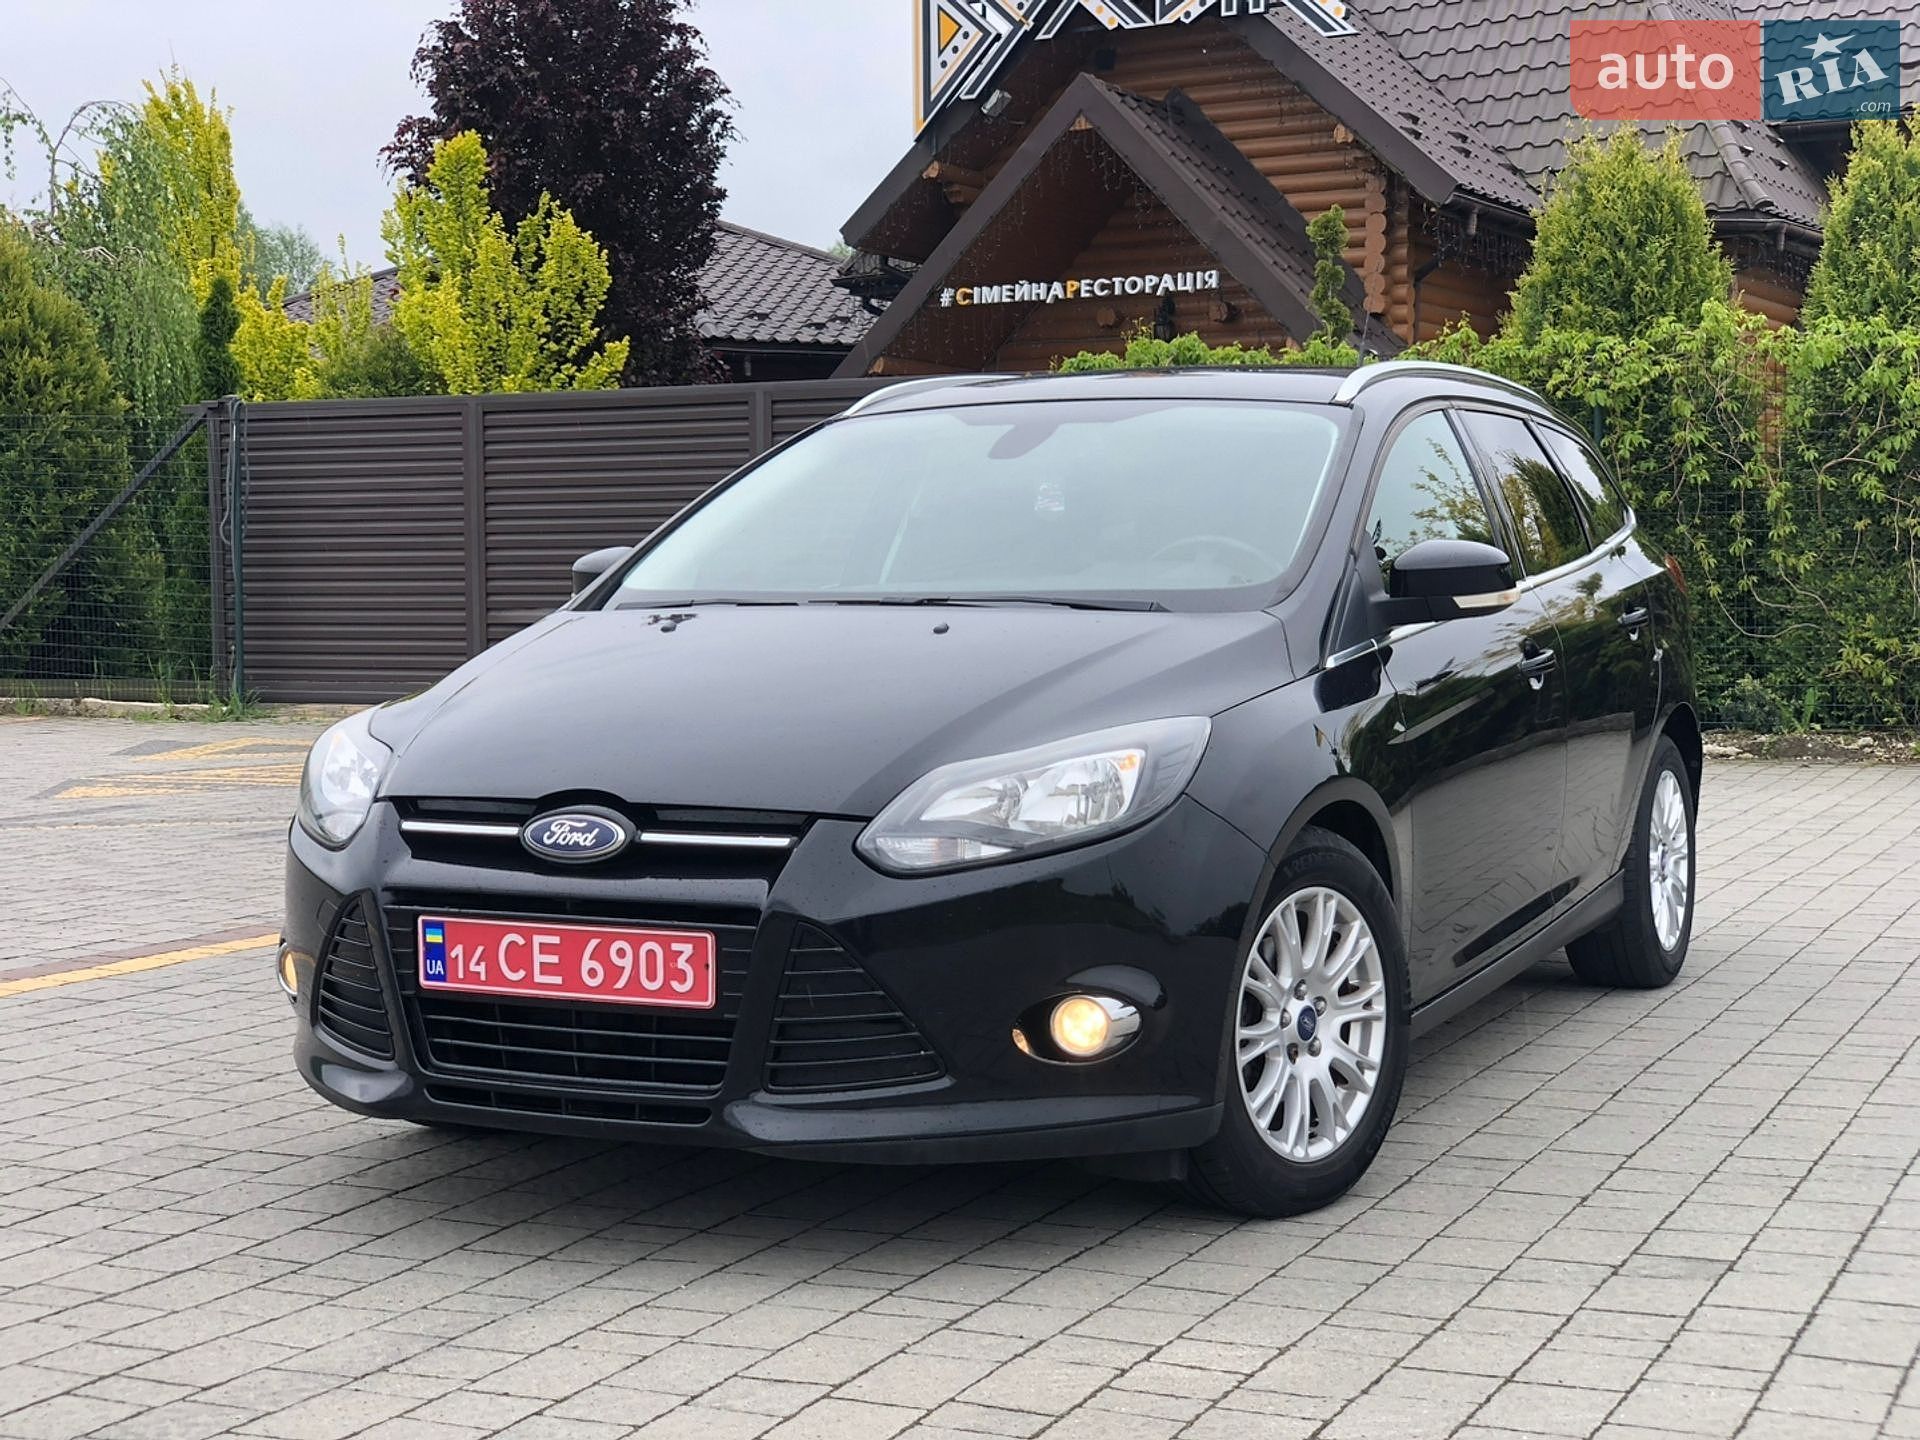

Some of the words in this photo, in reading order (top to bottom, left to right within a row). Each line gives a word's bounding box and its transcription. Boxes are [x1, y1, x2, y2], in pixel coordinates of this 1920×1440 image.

[543, 819, 597, 848] Ford
[426, 959, 444, 975] UA
[450, 944, 487, 981] 14
[498, 933, 563, 985] CE
[580, 938, 695, 993] 6903
